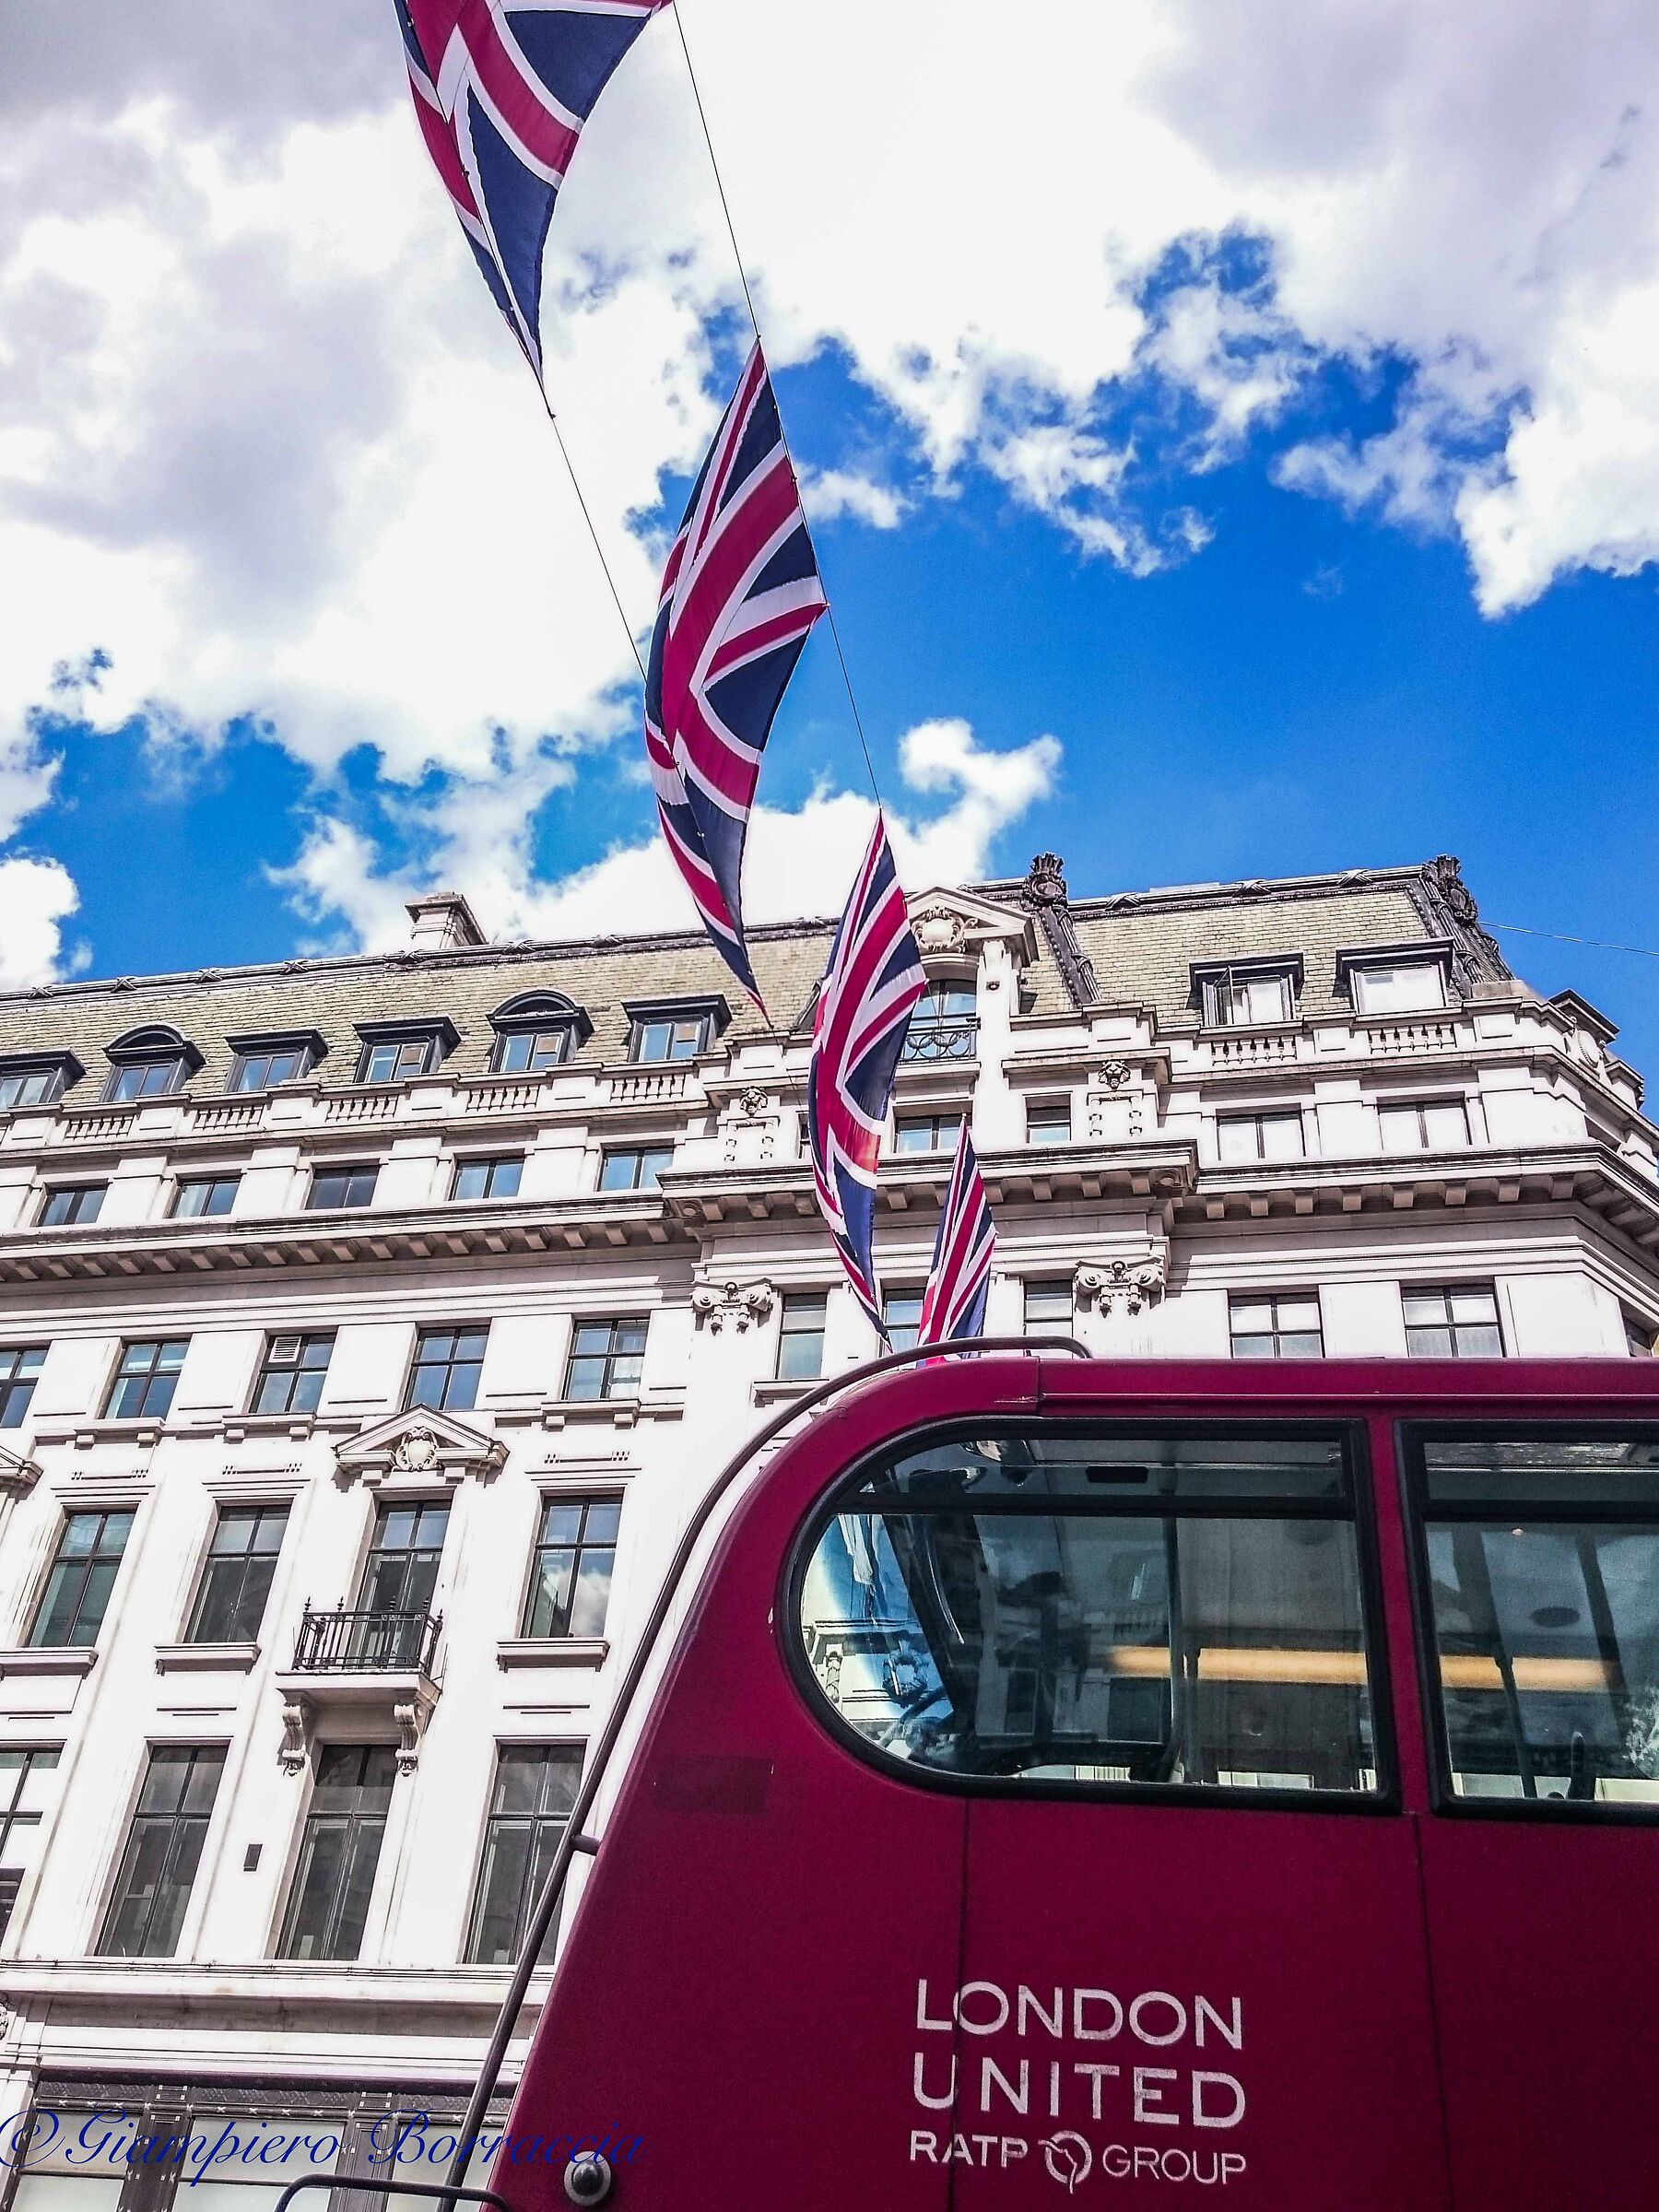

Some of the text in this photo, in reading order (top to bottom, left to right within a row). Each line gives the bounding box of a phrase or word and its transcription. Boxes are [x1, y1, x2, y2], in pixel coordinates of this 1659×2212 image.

[916, 1979, 1242, 2050] LONDON
[913, 2052, 1246, 2128] UNITED
[910, 2130, 1247, 2184] RATP GROUP
